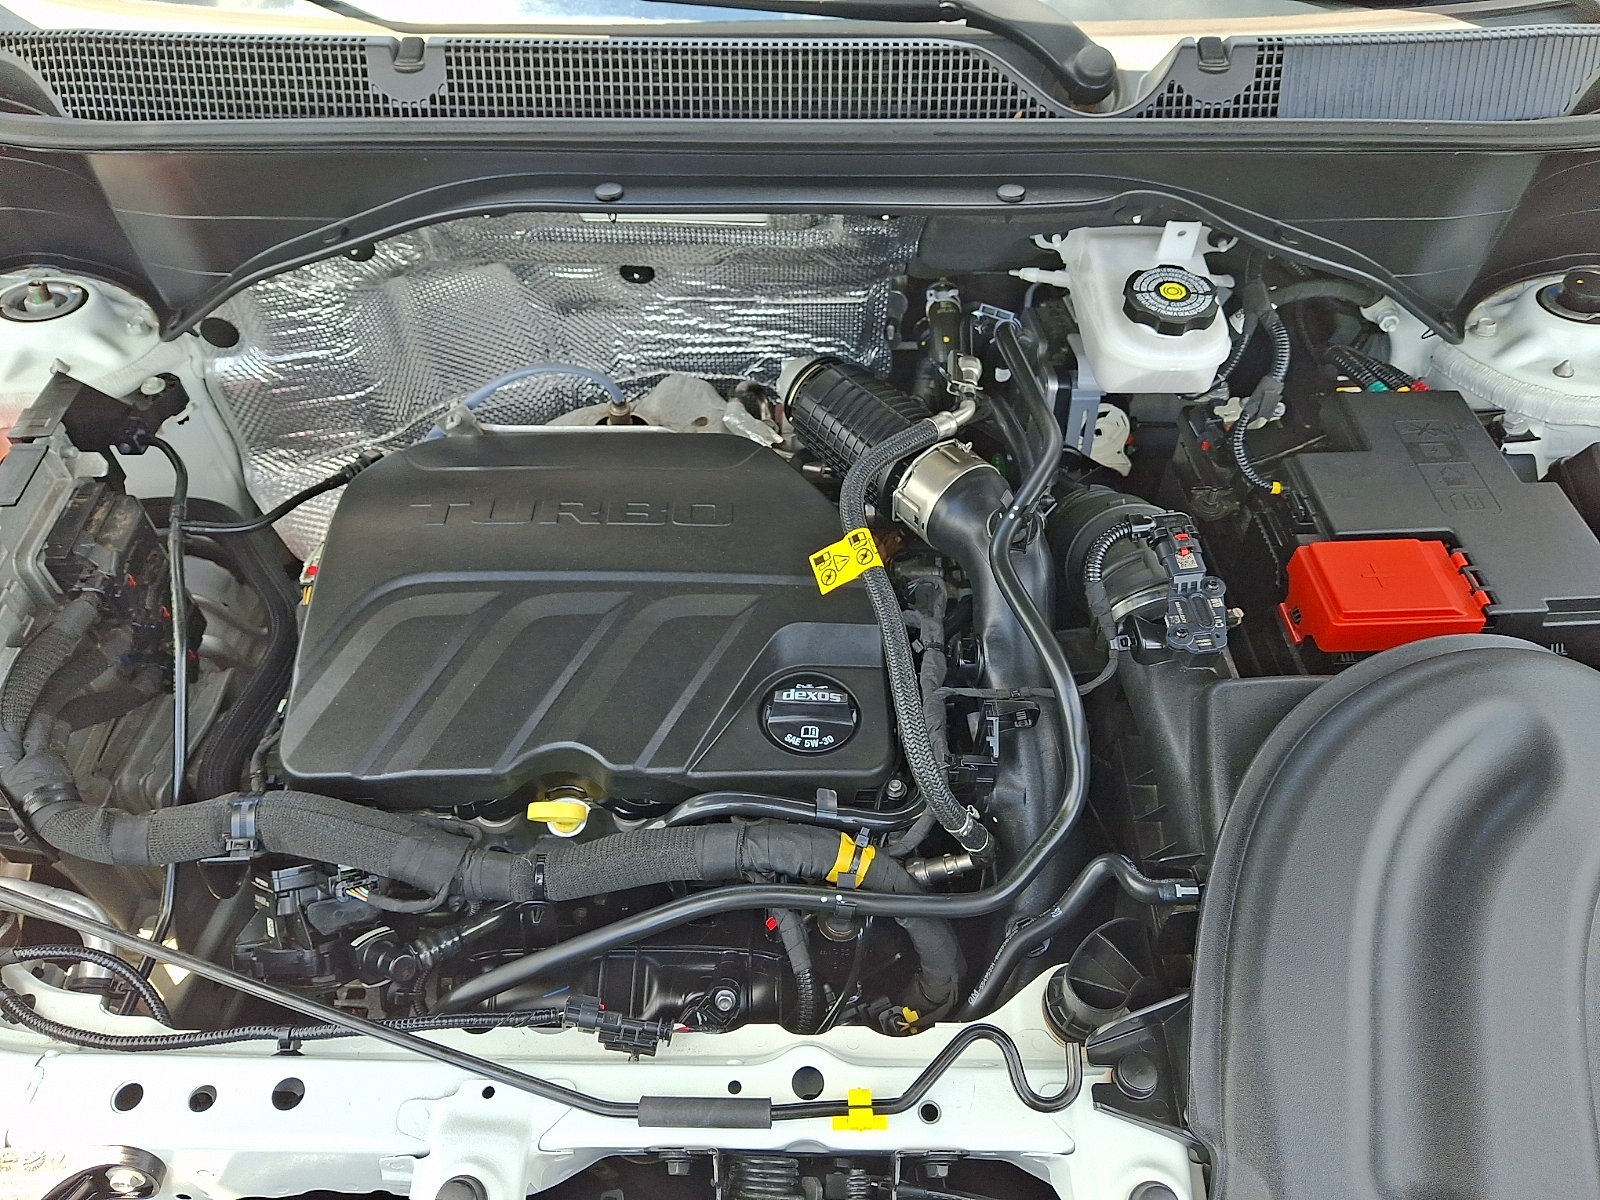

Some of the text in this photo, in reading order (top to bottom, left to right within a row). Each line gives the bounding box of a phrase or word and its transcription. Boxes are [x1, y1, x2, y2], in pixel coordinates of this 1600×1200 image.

[409, 500, 734, 526] TURBO
[782, 689, 843, 702] dexos
[784, 733, 834, 748] SAE 5W-30
